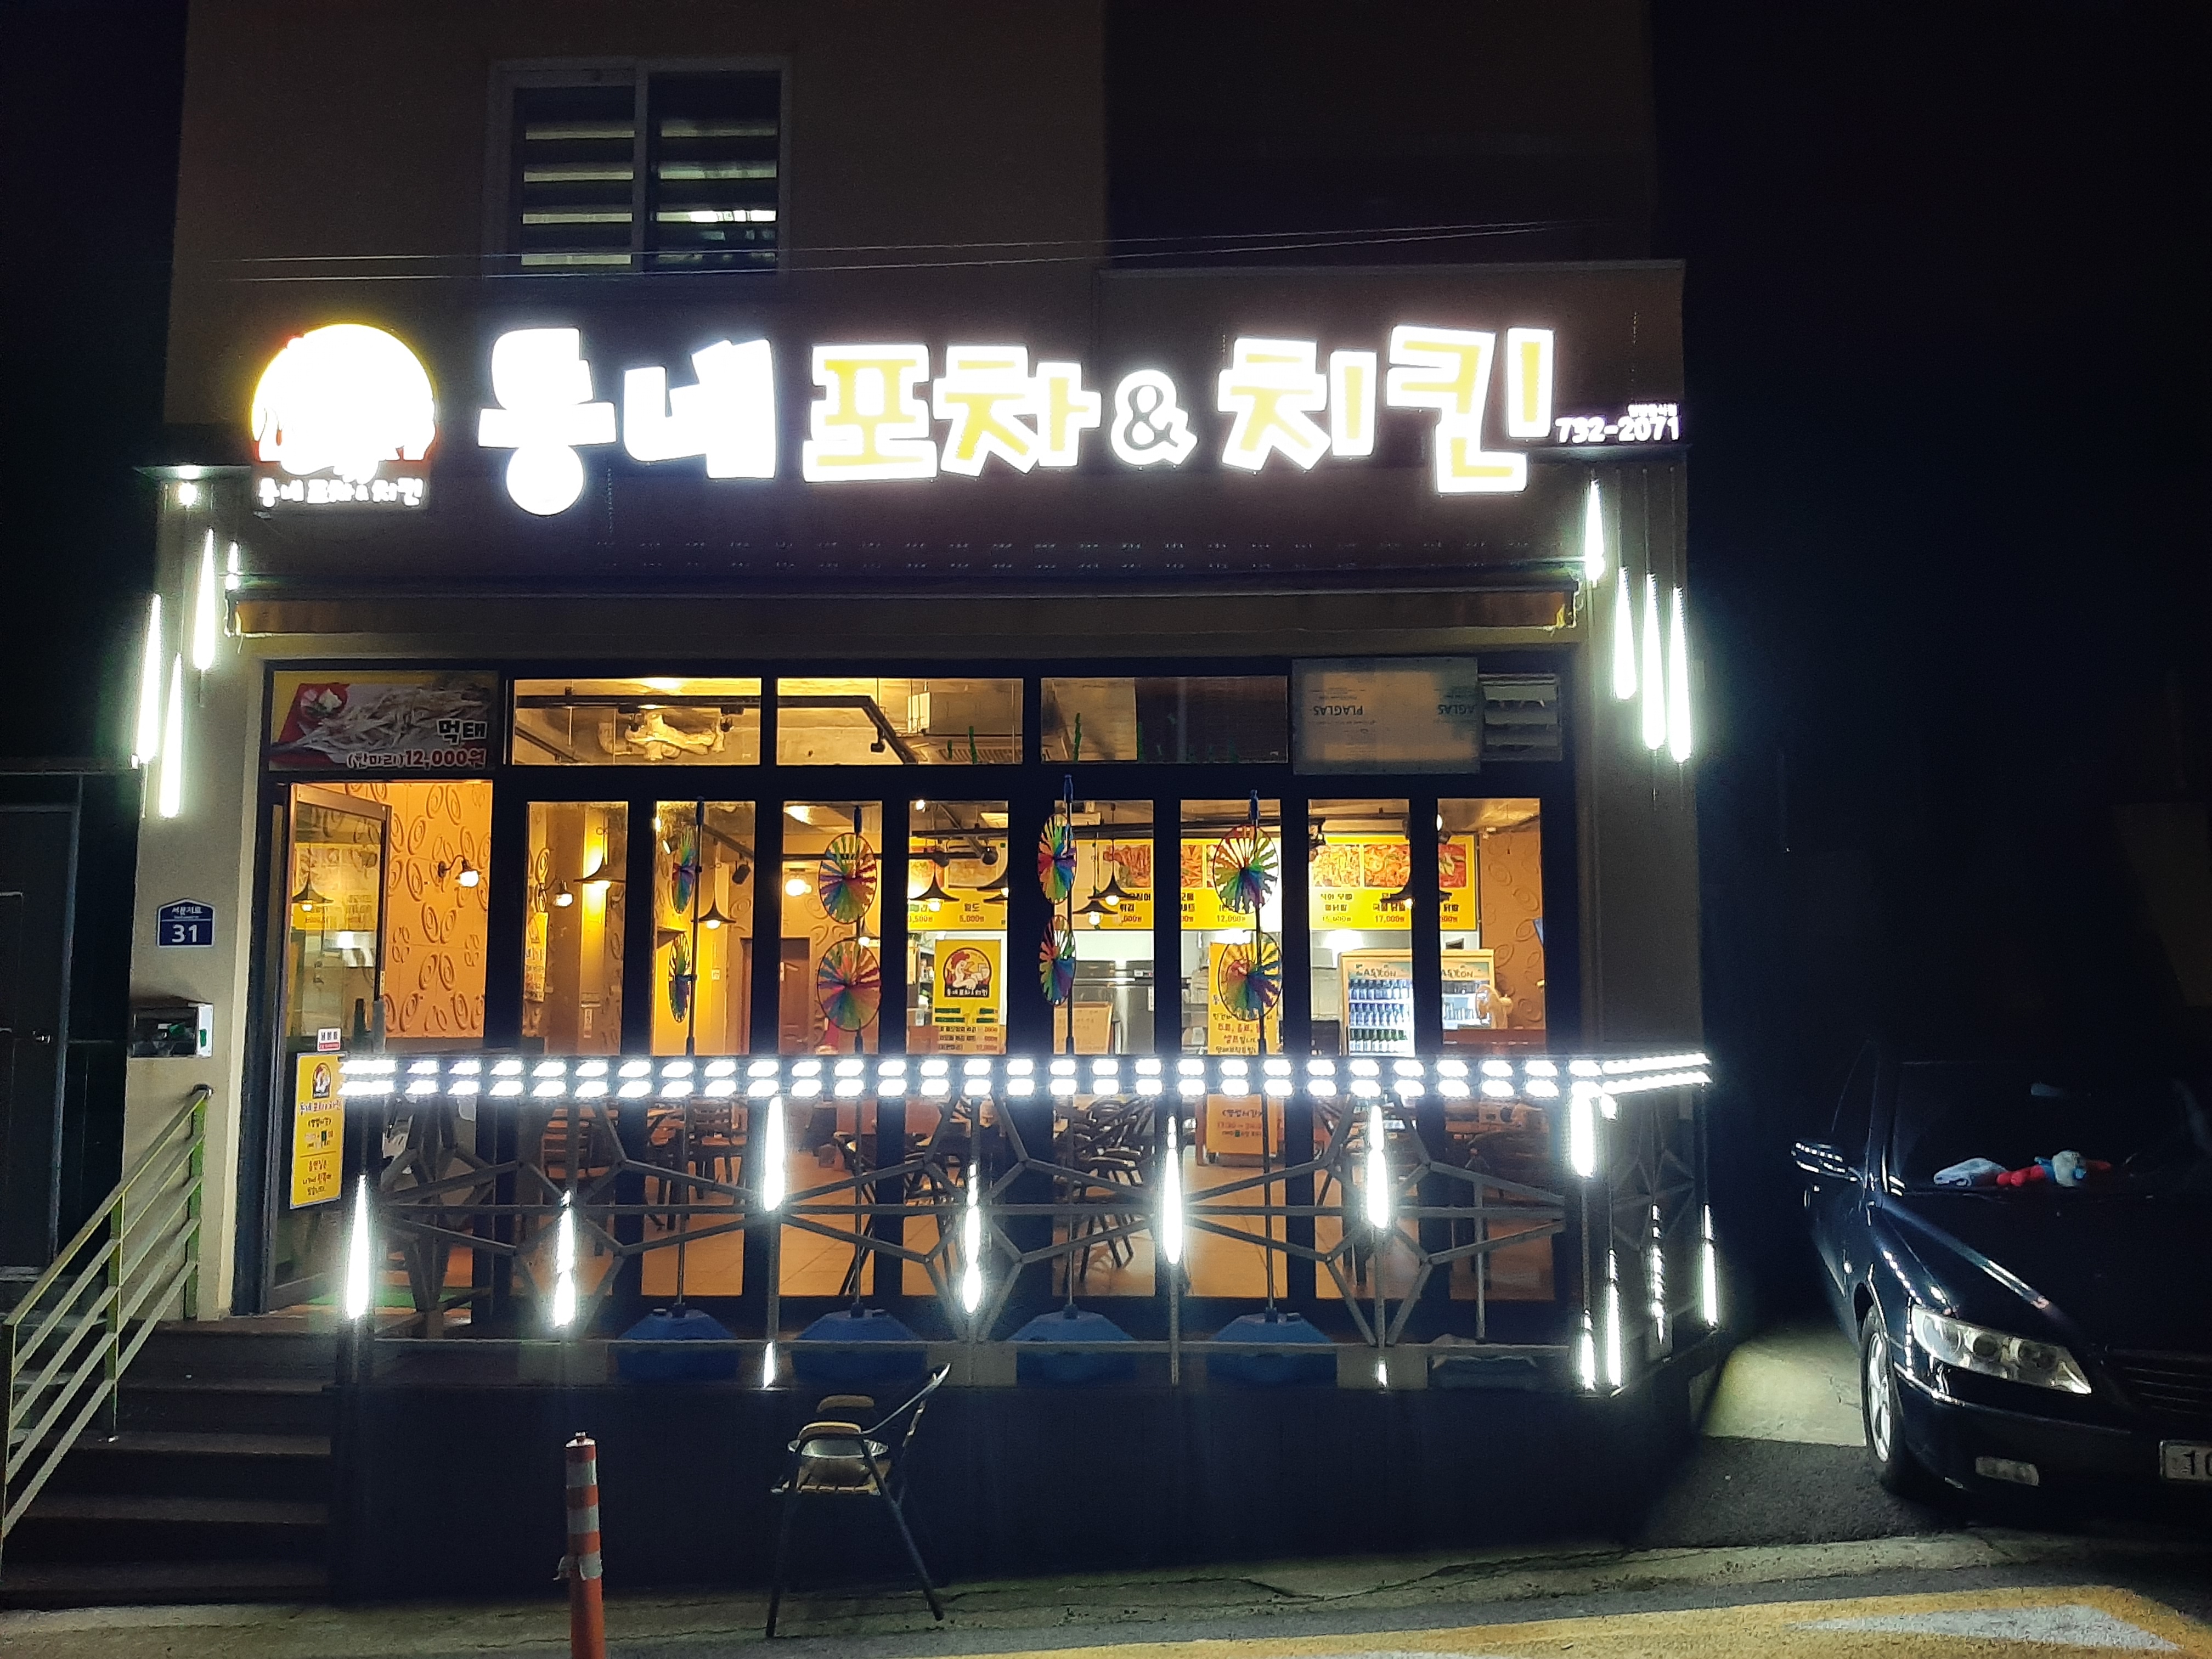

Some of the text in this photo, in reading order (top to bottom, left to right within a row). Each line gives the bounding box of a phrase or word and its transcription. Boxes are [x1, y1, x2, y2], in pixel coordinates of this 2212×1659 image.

[802, 341, 1102, 482] 포차
[1110, 369, 1199, 469] &
[1217, 323, 1556, 495] 치킨
[1313, 705, 1363, 716] PLAGLAS
[437, 719, 488, 746] 먹태
[172, 924, 198, 943] 31
